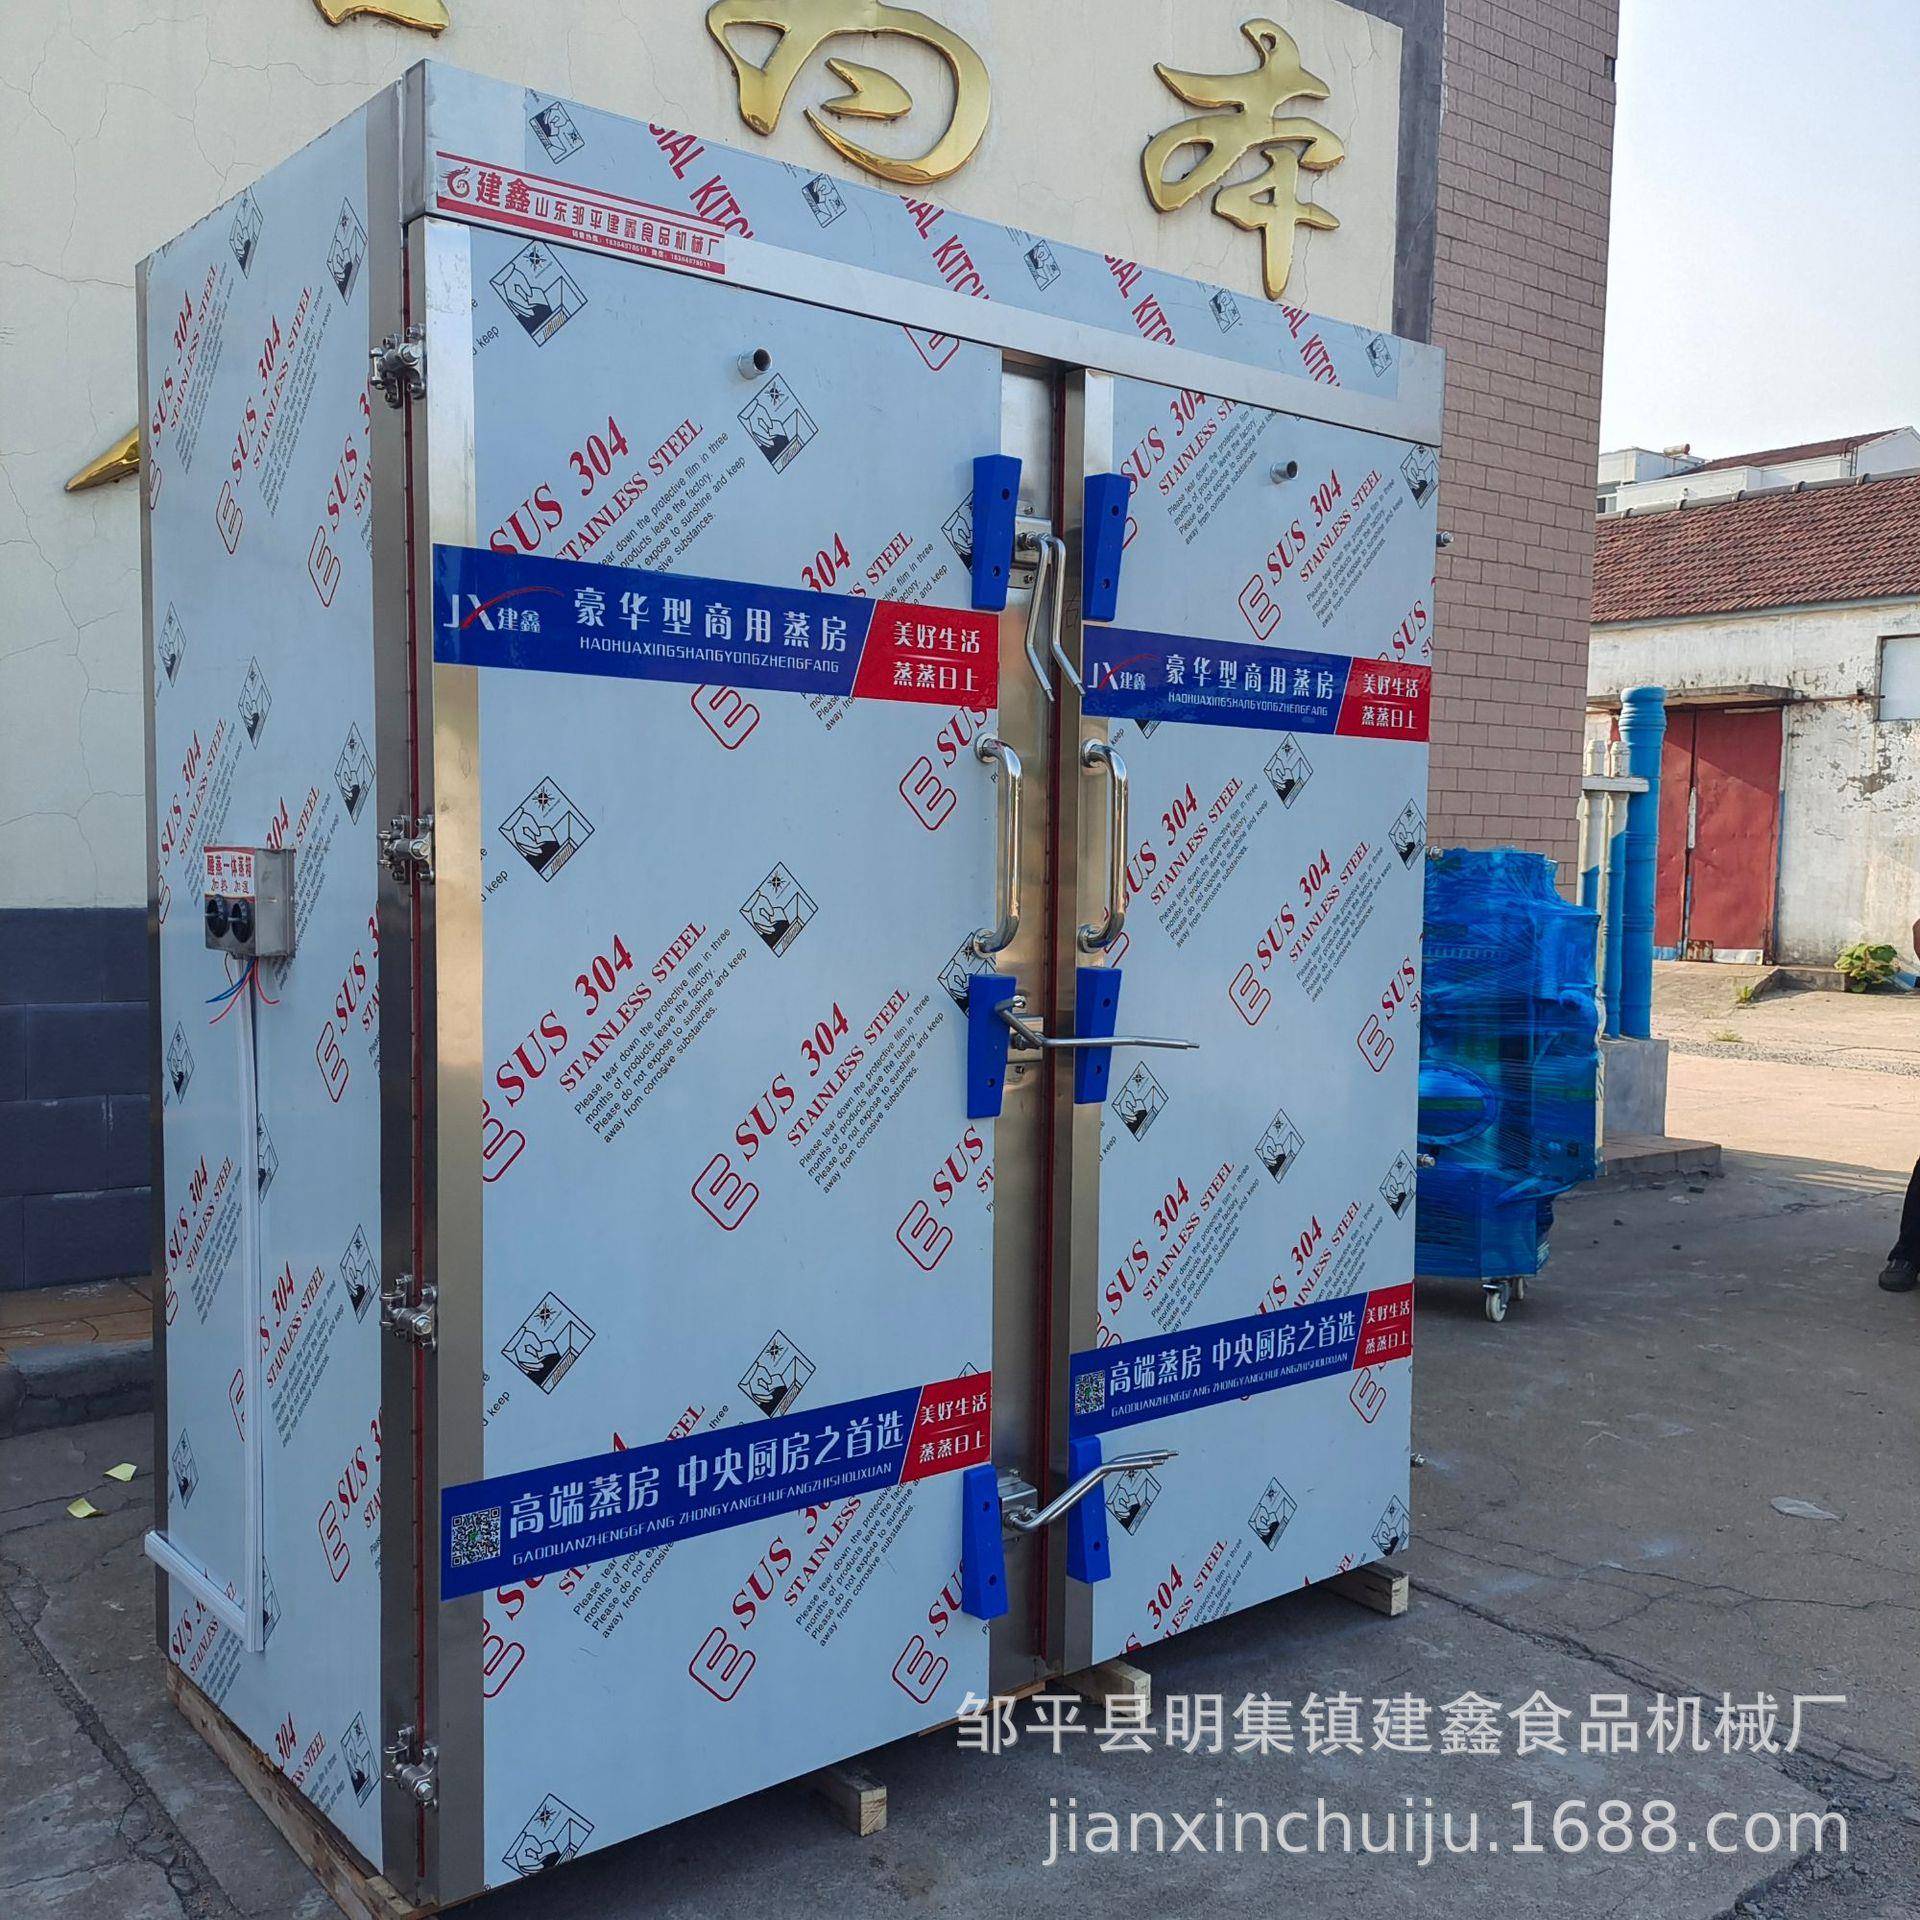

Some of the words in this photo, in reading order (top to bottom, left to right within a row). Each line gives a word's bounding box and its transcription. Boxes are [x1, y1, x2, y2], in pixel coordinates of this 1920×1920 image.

[475, 170, 531, 215] 建鑫
[476, 324, 500, 355] keep
[231, 396, 258, 487] SUS
[257, 314, 281, 397] 304
[327, 433, 358, 536] SUS
[569, 415, 629, 497] 304
[647, 418, 704, 478] STEEL
[1158, 417, 1218, 497] STAINLESS
[866, 531, 913, 587] STEEL
[1265, 516, 1306, 589] SUS
[1310, 467, 1343, 528] 304
[1299, 508, 1352, 585] STAINLESS
[1351, 469, 1383, 513] STEEL
[496, 607, 542, 634] 建鑫
[573, 586, 848, 652] 豪华型商用蒸房
[893, 620, 980, 655] 美好生活
[1393, 600, 1427, 661] SUS
[893, 661, 980, 693] 蒸蒸日上
[1120, 671, 1147, 691] 建鑫
[1165, 653, 1334, 700] 豪华型商用蒸房
[1363, 673, 1419, 698] 美好生活
[1361, 705, 1418, 730] 蒸蒸日上
[161, 792, 183, 866] SUS
[296, 785, 320, 845] STEEL
[1149, 821, 1209, 907] STAINLESS
[1208, 776, 1244, 825] STEEL
[1161, 782, 1198, 847] 304
[485, 869, 509, 893] keep
[1255, 901, 1295, 974] SUS
[1298, 847, 1331, 908] 304
[1288, 883, 1341, 965] STAINLESS
[1339, 840, 1371, 887] STEEL
[336, 950, 366, 1035] SUS
[495, 1009, 568, 1108] SUS
[574, 934, 634, 1016] 304
[559, 981, 652, 1093] STAINLESS
[651, 921, 707, 984] STEEL
[574, 1083, 603, 1115] Please
[601, 1062, 619, 1083] tear
[619, 1037, 641, 1062] down
[638, 1021, 654, 1037] the
[654, 979, 689, 1023] protective
[687, 961, 704, 979] film
[702, 951, 712, 962] in
[710, 928, 731, 951] three
[1382, 956, 1415, 1021] SUS
[584, 1090, 614, 1125] months
[613, 1076, 624, 1090] of
[623, 1040, 655, 1081] products
[652, 1015, 676, 1040] leave
[674, 999, 689, 1015] the
[687, 968, 716, 999] factory.
[592, 1102, 622, 1134] Please
[621, 1088, 633, 1101] do
[632, 1069, 649, 1087] not
[646, 1038, 674, 1070] expose
[672, 1026, 683, 1038] to
[683, 988, 714, 1026] sunshine
[714, 968, 730, 988] and
[727, 948, 747, 970] keep
[603, 1117, 625, 1144] away
[623, 1095, 644, 1117] from
[643, 1055, 676, 1095] corrosive
[676, 1006, 718, 1054] substances.
[786, 1044, 865, 1149] STAINLESS
[864, 989, 910, 1047] STEEL
[734, 1071, 795, 1164] SUS
[800, 1001, 850, 1078] 304
[798, 1138, 823, 1169] Please
[821, 1119, 837, 1138] tear
[836, 1096, 855, 1119] down
[853, 1081, 866, 1096] the
[866, 1041, 895, 1082] protective
[893, 1025, 908, 1042] film
[906, 1015, 915, 1026] in
[912, 994, 930, 1016] three
[807, 1145, 832, 1178] months
[831, 1132, 841, 1145] of
[839, 1098, 867, 1136] products
[864, 1075, 884, 1098] leave
[882, 1060, 895, 1075] the
[893, 1031, 917, 1060] factory.
[814, 1156, 838, 1186] Please
[837, 1142, 848, 1155] do
[847, 1125, 861, 1142] not
[859, 1096, 882, 1126] expose
[880, 1085, 890, 1096] to
[889, 1049, 916, 1085] sunshine
[915, 1030, 929, 1049] and
[926, 1012, 943, 1033] keep
[823, 1169, 841, 1194] away
[839, 1149, 857, 1170] from
[856, 1112, 884, 1149] corrosive
[883, 1066, 919, 1111] substances.
[933, 1124, 984, 1208] SUS
[1103, 1238, 1149, 1318] SUS
[1152, 1175, 1190, 1242] 304
[1142, 1211, 1201, 1303] STAINLESS
[1200, 1161, 1235, 1212] STEEL
[1290, 1214, 1323, 1276] 304
[1331, 1200, 1362, 1248] STEEL
[271, 1260, 295, 1328] 304
[301, 1265, 326, 1315] STEEL
[1366, 1300, 1410, 1325] 美好生活
[1110, 1344, 1201, 1397] 高端蒸房
[1212, 1310, 1356, 1371] 中央厨房之首选
[1364, 1330, 1409, 1355] 蒸蒸日上
[487, 1391, 511, 1418] keep
[919, 1391, 988, 1426] 美好生活
[337, 1445, 369, 1521] SUS
[509, 1465, 661, 1539] 高端蒸房
[677, 1409, 904, 1497] 中央厨房之首选
[918, 1430, 987, 1464] 蒸蒸日上
[731, 1534, 792, 1632] SUS
[783, 1494, 862, 1608] STAINLESS
[1193, 1539, 1228, 1593] STEEL
[1146, 1563, 1183, 1631] 304
